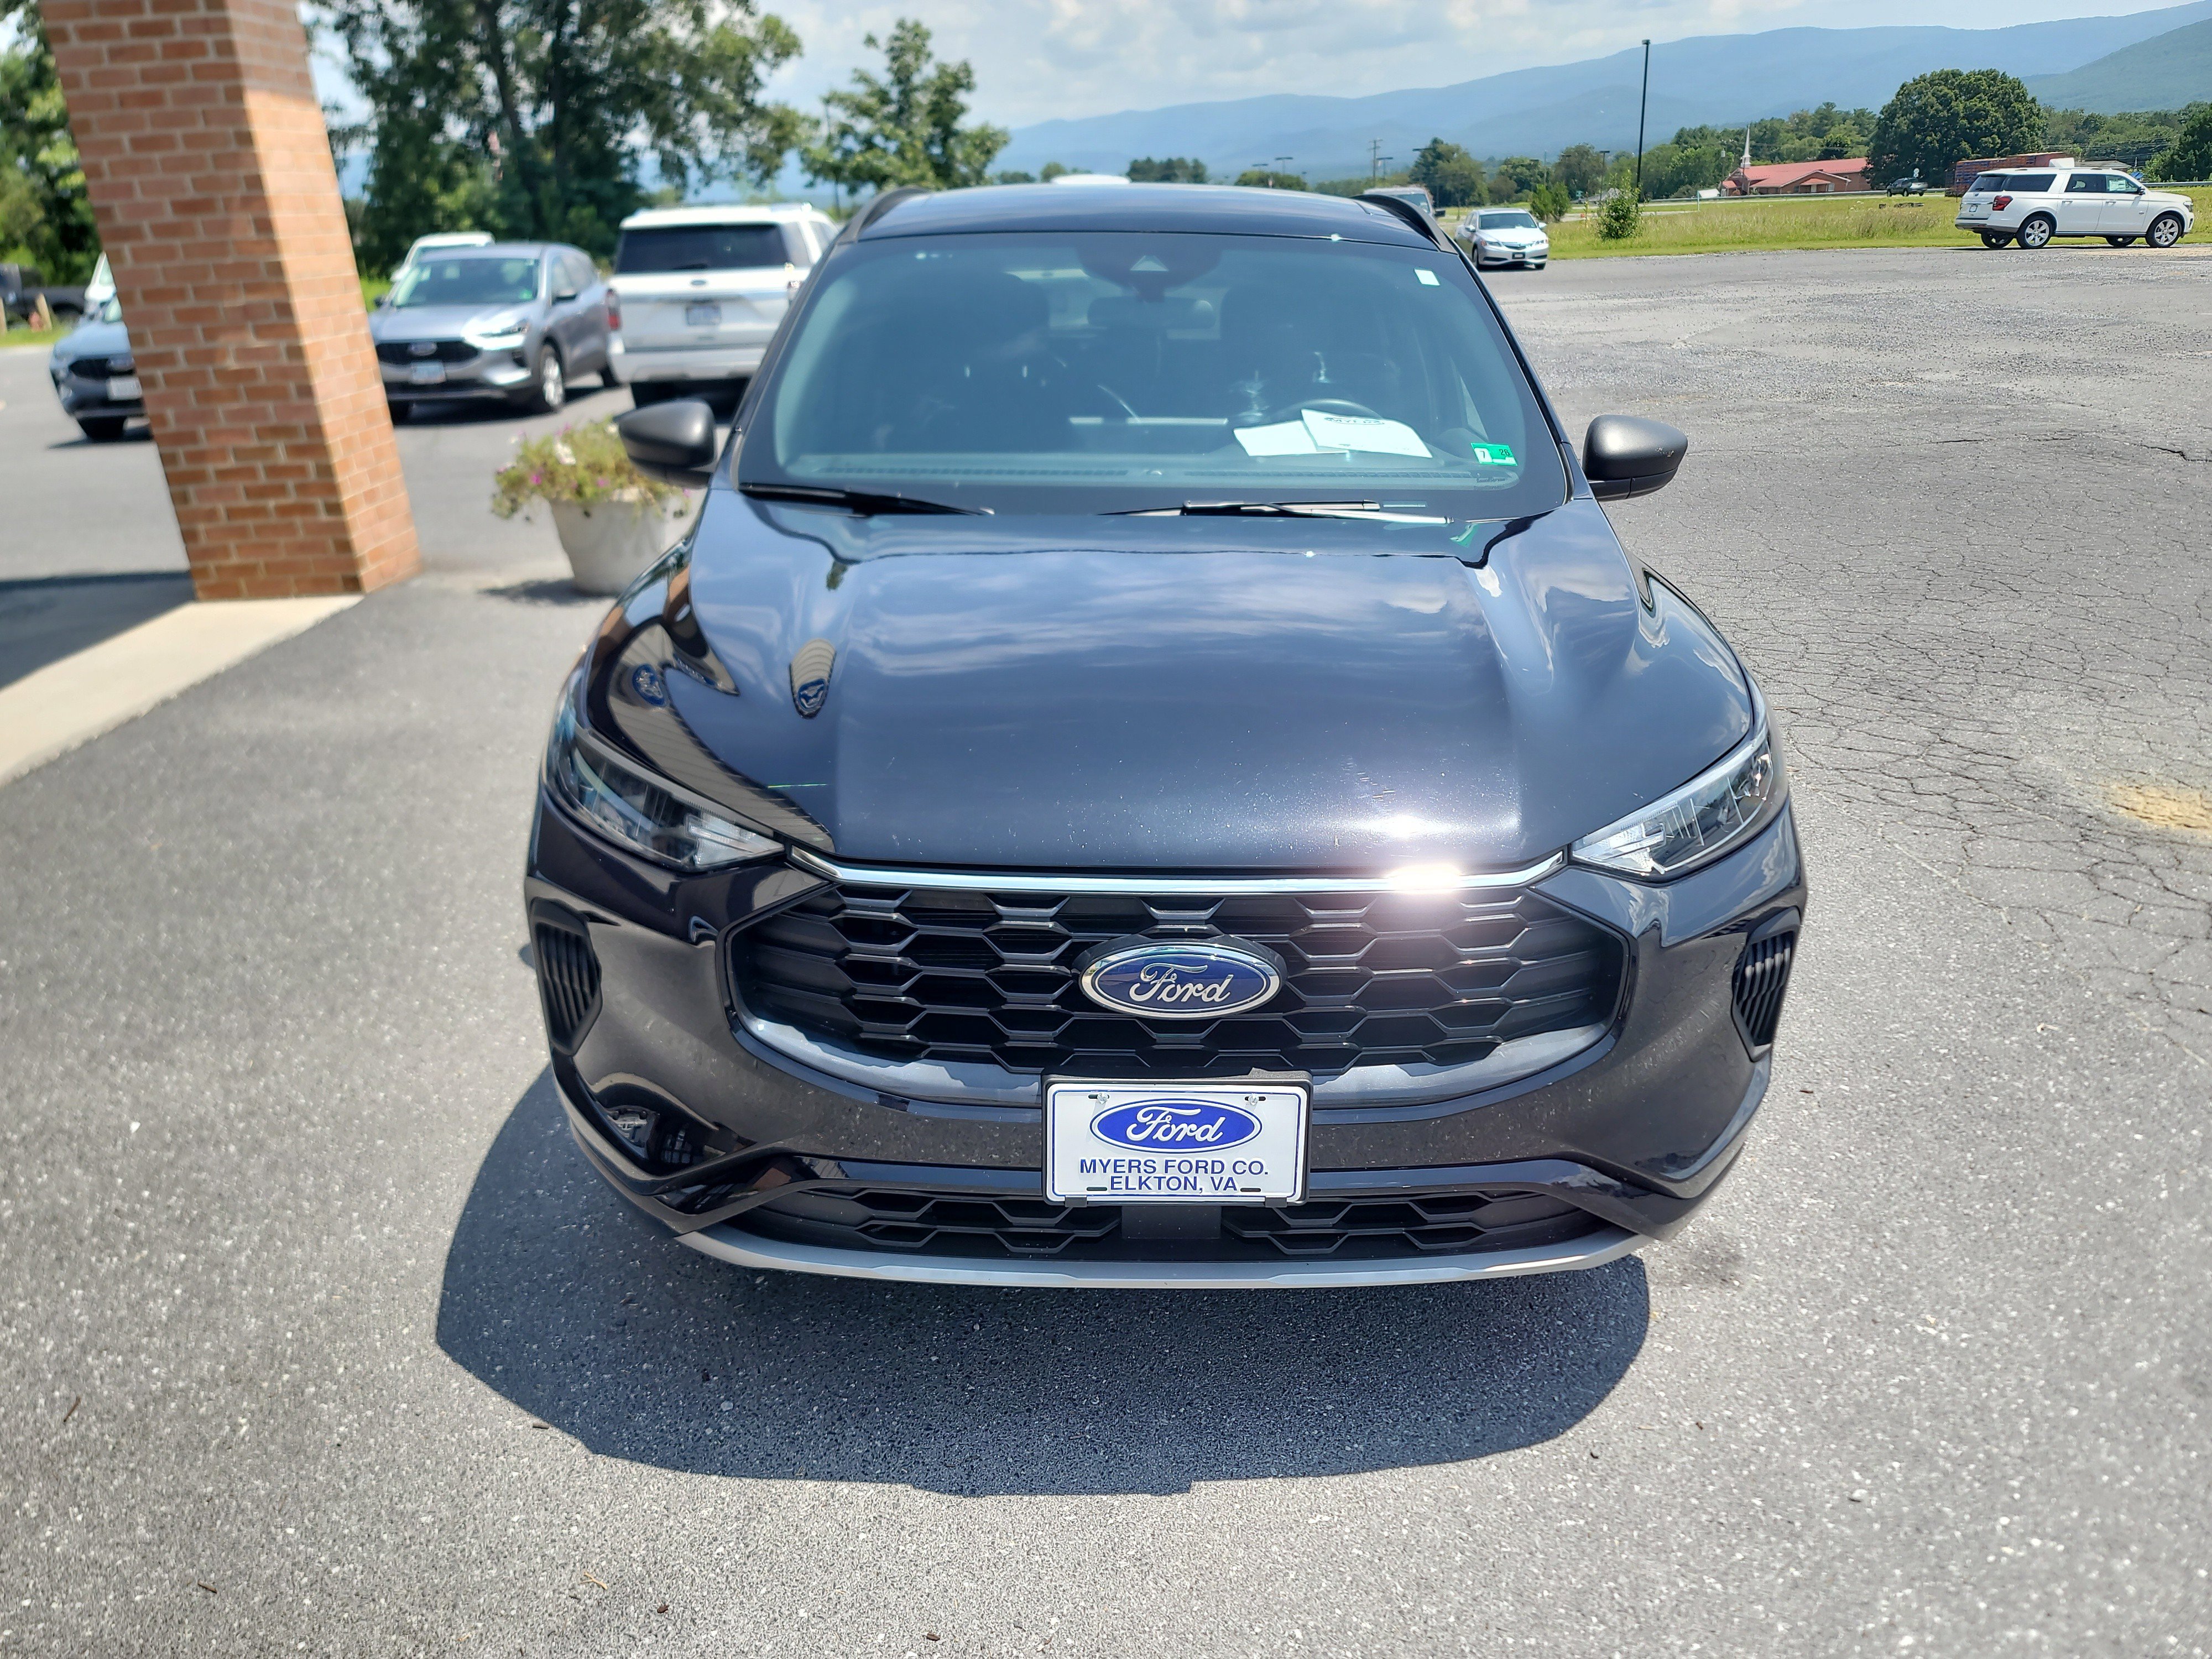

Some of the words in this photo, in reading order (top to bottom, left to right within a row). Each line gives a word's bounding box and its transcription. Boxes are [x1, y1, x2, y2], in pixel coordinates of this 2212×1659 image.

[1129, 963, 1234, 1002] Ford
[1126, 1107, 1226, 1142] Ford
[1080, 1159, 1157, 1175] MYERS
[1164, 1159, 1225, 1175] FORD
[1232, 1160, 1269, 1176] CO.
[1110, 1175, 1203, 1194] ELKTON,
[1210, 1176, 1238, 1192] VA
